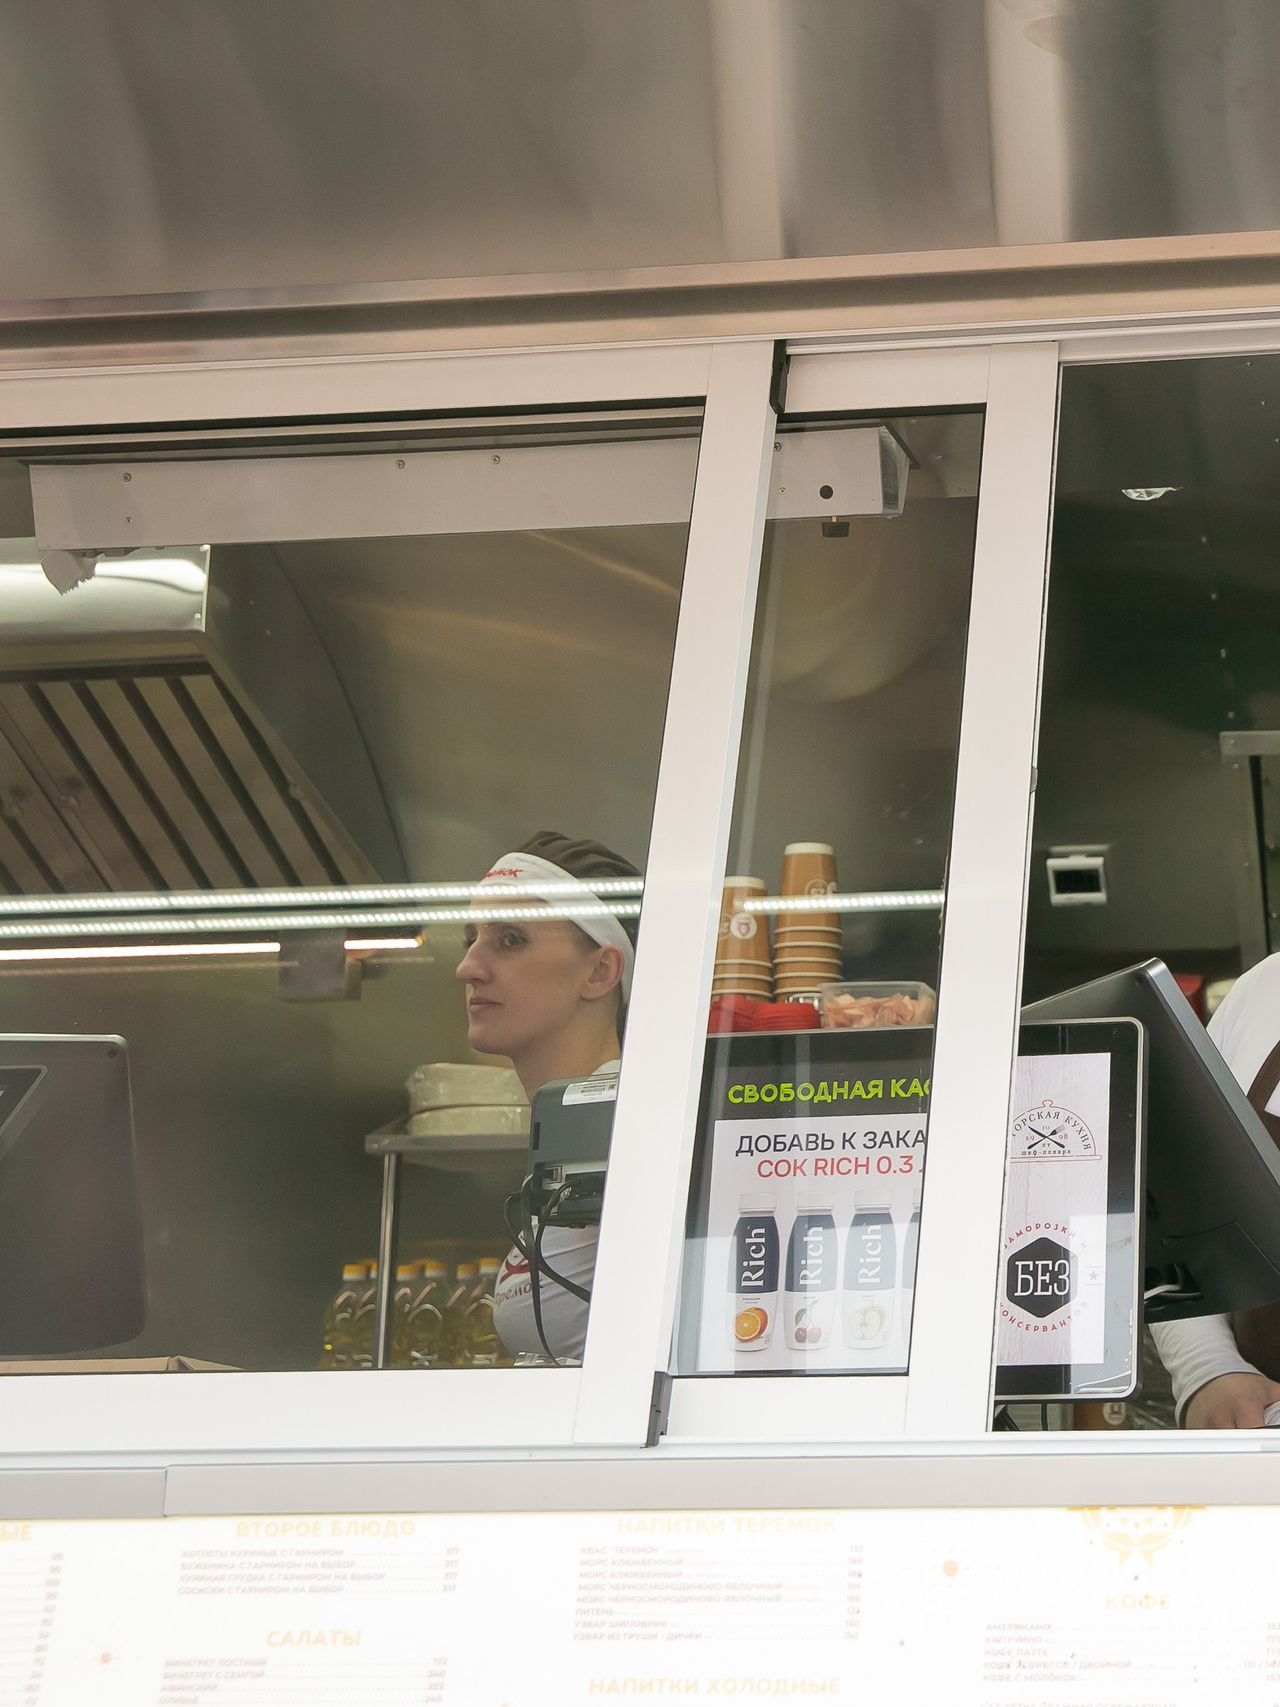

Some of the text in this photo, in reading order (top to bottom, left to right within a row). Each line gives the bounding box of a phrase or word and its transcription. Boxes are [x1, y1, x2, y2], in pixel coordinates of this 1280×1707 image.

[728, 1079, 883, 1104] СВОБОДНАЯ
[1059, 1133, 1068, 1141] 98
[1064, 1116, 1091, 1150] КУХНЯ
[735, 1132, 835, 1157] ДОБАВЬ
[842, 1132, 857, 1150] К
[757, 1159, 808, 1178] СОК
[814, 1157, 870, 1176] RICH
[876, 1155, 914, 1175] 0.3
[741, 1226, 767, 1287] Rich
[800, 1225, 824, 1285] Rich
[858, 1223, 883, 1284] Rich
[1014, 1259, 1070, 1297] БЕЗ
[236, 1520, 416, 1539] ВТОРОЕ БЛЮДО
[617, 1517, 837, 1534] НАПИТКИ ТЕРЕМОК
[182, 1550, 227, 1558] КОТЛЕТЫ
[230, 1549, 277, 1557] КУРИНЫЕ
[289, 1548, 344, 1556] ГАРНИРОМ
[445, 1547, 460, 1555] 317
[580, 1546, 607, 1554] КВАС
[180, 1562, 236, 1570] БУЖЕНИНА
[248, 1561, 302, 1569] ГАРНИРОМ
[305, 1561, 317, 1569] НА
[321, 1560, 357, 1568] ВЫБОР
[579, 1558, 608, 1567] МОРС
[610, 1557, 684, 1567] КЛЮКВЕННЫЙ
[179, 1574, 226, 1582] КУРИНАЯ
[228, 1574, 265, 1582] ГРУДКА
[277, 1573, 331, 1581] ГАРНИРОМ
[334, 1573, 347, 1581] НА
[351, 1572, 386, 1580] ВЫБОР
[443, 1572, 458, 1580] 317
[579, 1571, 608, 1579] МОРС
[610, 1569, 683, 1579] КЛЮКВЕННЫЙ
[178, 1586, 224, 1594] СОСИСКИ
[236, 1585, 290, 1594] ГАРНИРОМ
[292, 1585, 305, 1593] НА
[309, 1584, 344, 1593] ВЫБОР
[442, 1584, 457, 1592] 317
[578, 1583, 607, 1591] МОРС
[609, 1581, 783, 1592] ЧЕРНОСМОРОДИНОВО-ЯБЛОЧНЫЙ
[577, 1595, 606, 1603] МОРС
[608, 1594, 782, 1604] ЧЕРНОСМОРОДИНОВО-ЯБЛОЧНЫЙ
[1104, 1593, 1172, 1611] КОФЕ
[576, 1608, 615, 1616] ПИТЕНЬ
[574, 1620, 606, 1628] УЗВАР
[609, 1619, 668, 1628] ШИПОВНИК
[985, 1623, 1051, 1631] АМЕРИКАНО
[266, 1629, 361, 1647] САЛАТЫ
[573, 1632, 606, 1641] УЗВАР
[607, 1632, 620, 1640] ИЗ
[623, 1632, 658, 1641] ГРУШИ
[666, 1632, 702, 1641] ДИЧКИ
[984, 1635, 1043, 1643] КАПУЧИНО
[1266, 1635, 1280, 1643] 175
[984, 1648, 1012, 1656] КОФЕ
[1016, 1648, 1048, 1656] ЛАТТЕ
[165, 1657, 447, 1667] ВИНЕГРЕТ ПОСТНЫЙ 172
[983, 1661, 1012, 1669] КОФЕ
[1079, 1660, 1132, 1670] ДВОЙНОЙ
[163, 1671, 213, 1680] ВИНЕГРЕТ
[982, 1674, 1012, 1682] КОФЕ
[1014, 1673, 1021, 1681] С
[1266, 1673, 1280, 1681] 153
[588, 1677, 842, 1697] НАПИТКИ ХОЛОДНЫЕ
